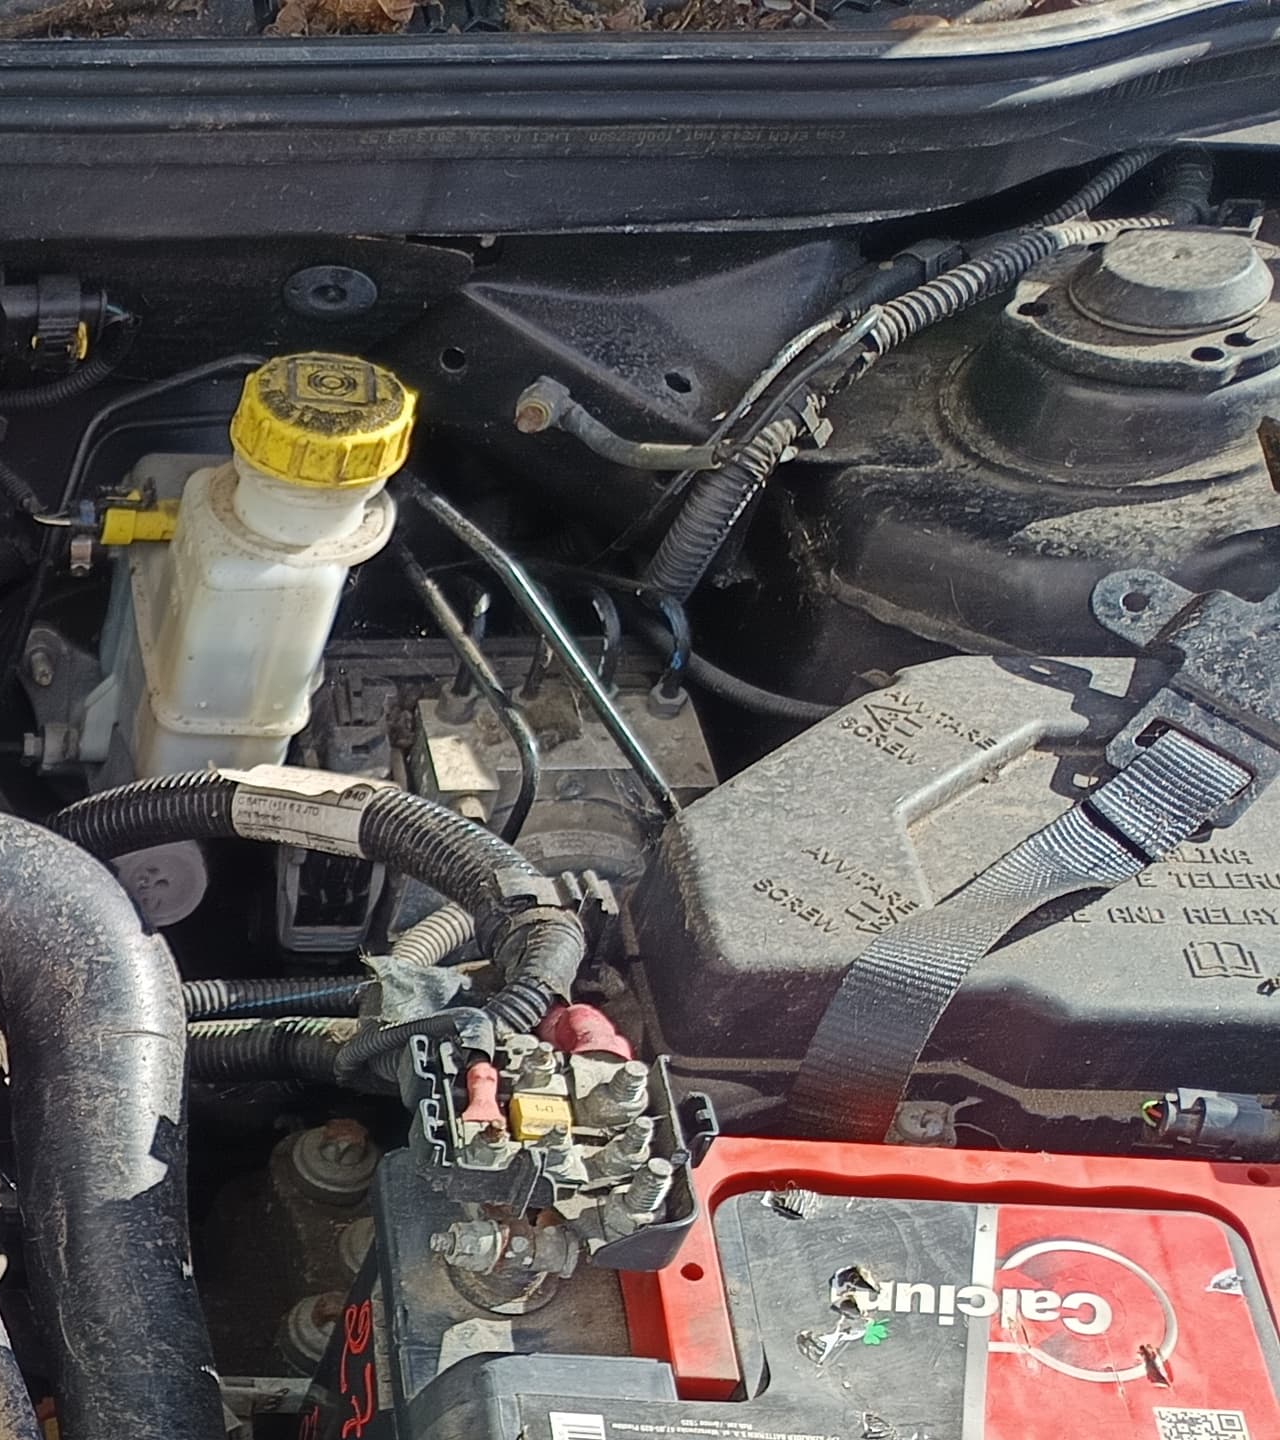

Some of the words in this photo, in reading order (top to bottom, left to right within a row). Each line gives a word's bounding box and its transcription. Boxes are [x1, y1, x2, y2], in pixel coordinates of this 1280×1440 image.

[1159, 847, 1254, 865] ALINA
[753, 878, 840, 933] SCREW
[1107, 906, 1166, 924] AND
